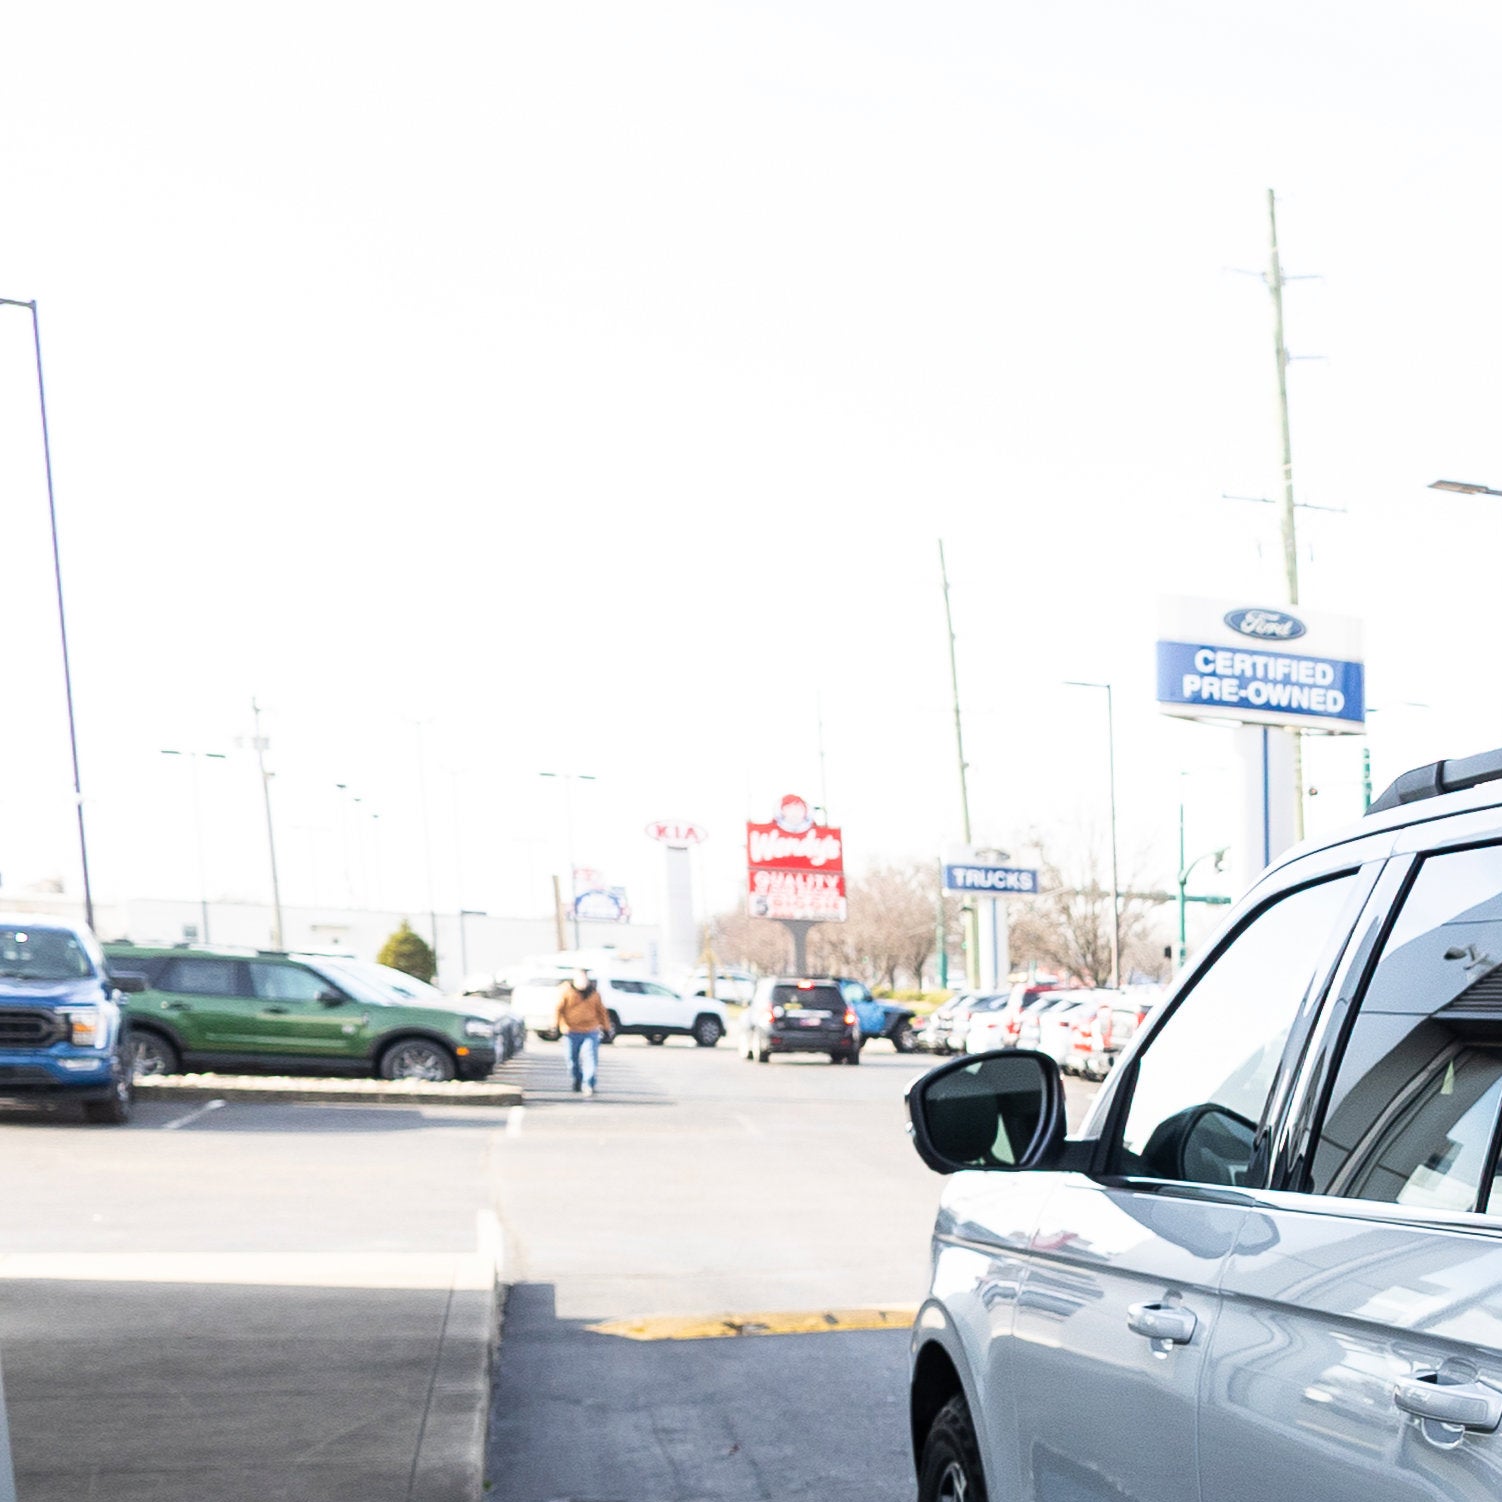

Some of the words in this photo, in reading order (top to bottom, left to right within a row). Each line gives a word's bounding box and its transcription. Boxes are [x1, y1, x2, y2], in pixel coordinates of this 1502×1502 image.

[1240, 609, 1294, 637] Ford
[1194, 648, 1335, 687] CERTIFIED
[1182, 673, 1346, 714] PRE-OWNED
[655, 824, 700, 842] KIA
[952, 867, 1034, 891] TRUCKS
